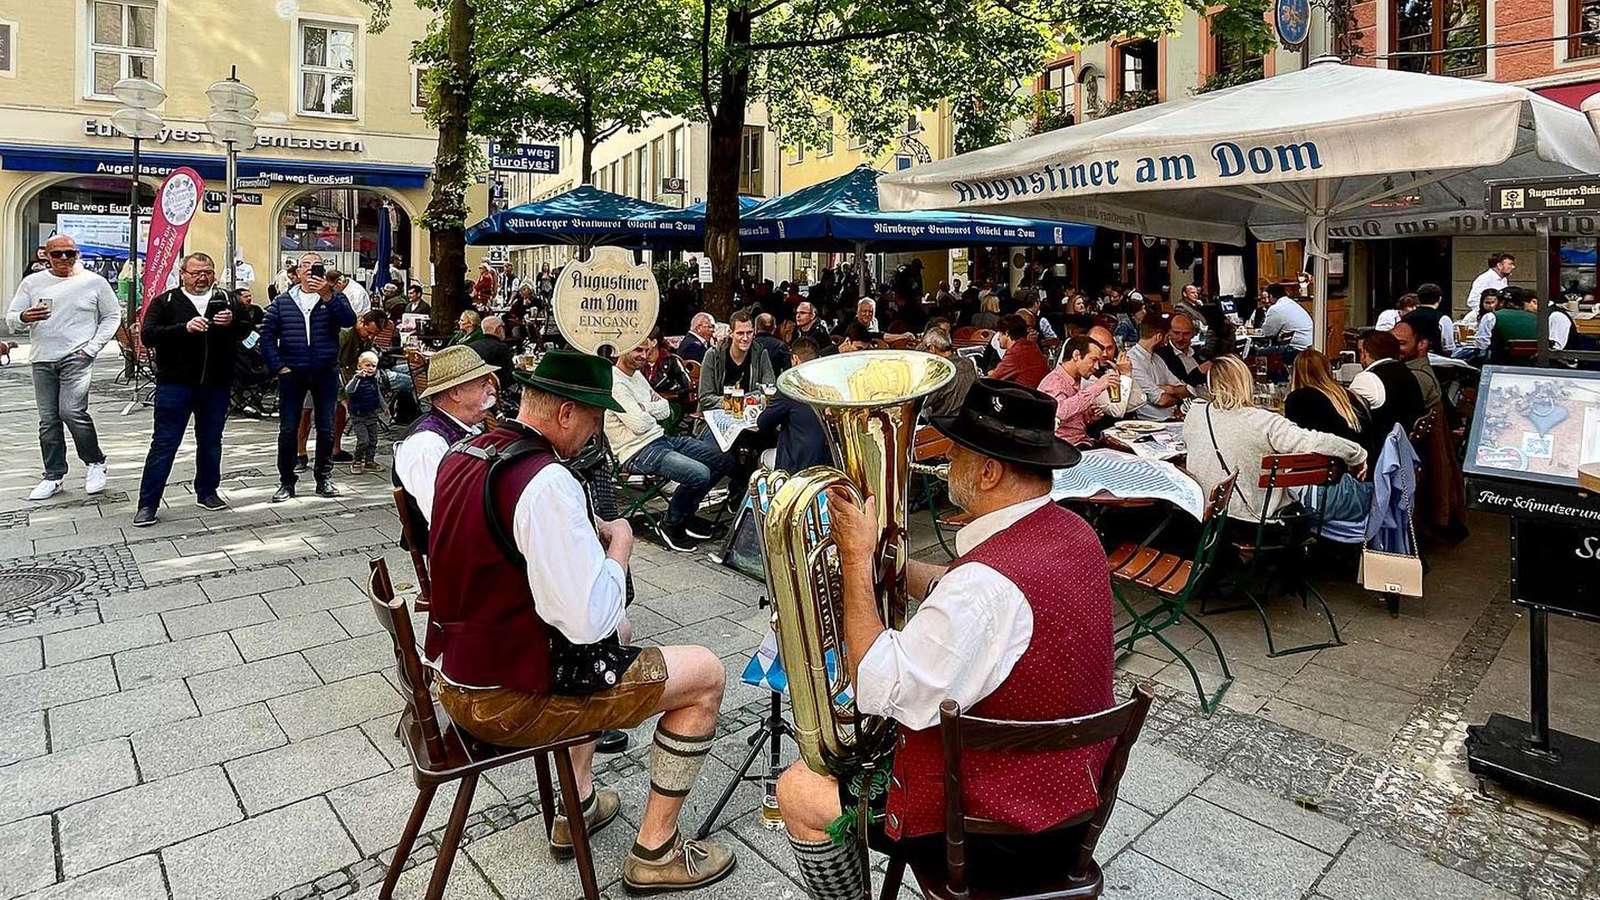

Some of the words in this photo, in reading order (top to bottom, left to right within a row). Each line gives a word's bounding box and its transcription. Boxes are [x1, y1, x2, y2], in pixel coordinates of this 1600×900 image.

[526, 148, 555, 159] weg:
[492, 156, 555, 170] EuroEyes!
[951, 160, 1119, 204] Augustiner
[1136, 152, 1197, 184] am
[1210, 140, 1323, 179] Dom
[285, 175, 307, 184] weg:
[308, 174, 354, 185] EuroEyes!
[51, 201, 80, 211] Brille
[81, 203, 108, 214] weg:
[1544, 197, 1585, 207] München
[506, 217, 569, 230] Nürnberger
[571, 218, 622, 229] Bratwurst
[627, 219, 657, 229] Glöckl
[659, 222, 674, 230] am
[675, 221, 696, 231] Dom
[874, 223, 925, 236] Nürnberger
[928, 224, 972, 235] Bratwurst
[975, 226, 1001, 236] Glöckl
[1003, 229, 1016, 237] am
[1017, 228, 1036, 238] Dom
[571, 270, 649, 291] Augustiner
[581, 297, 602, 310] am
[606, 293, 637, 312] Dom
[579, 315, 639, 328] EINGANG
[1478, 490, 1513, 506] Peter
[1513, 496, 1579, 516] Schmutzer
